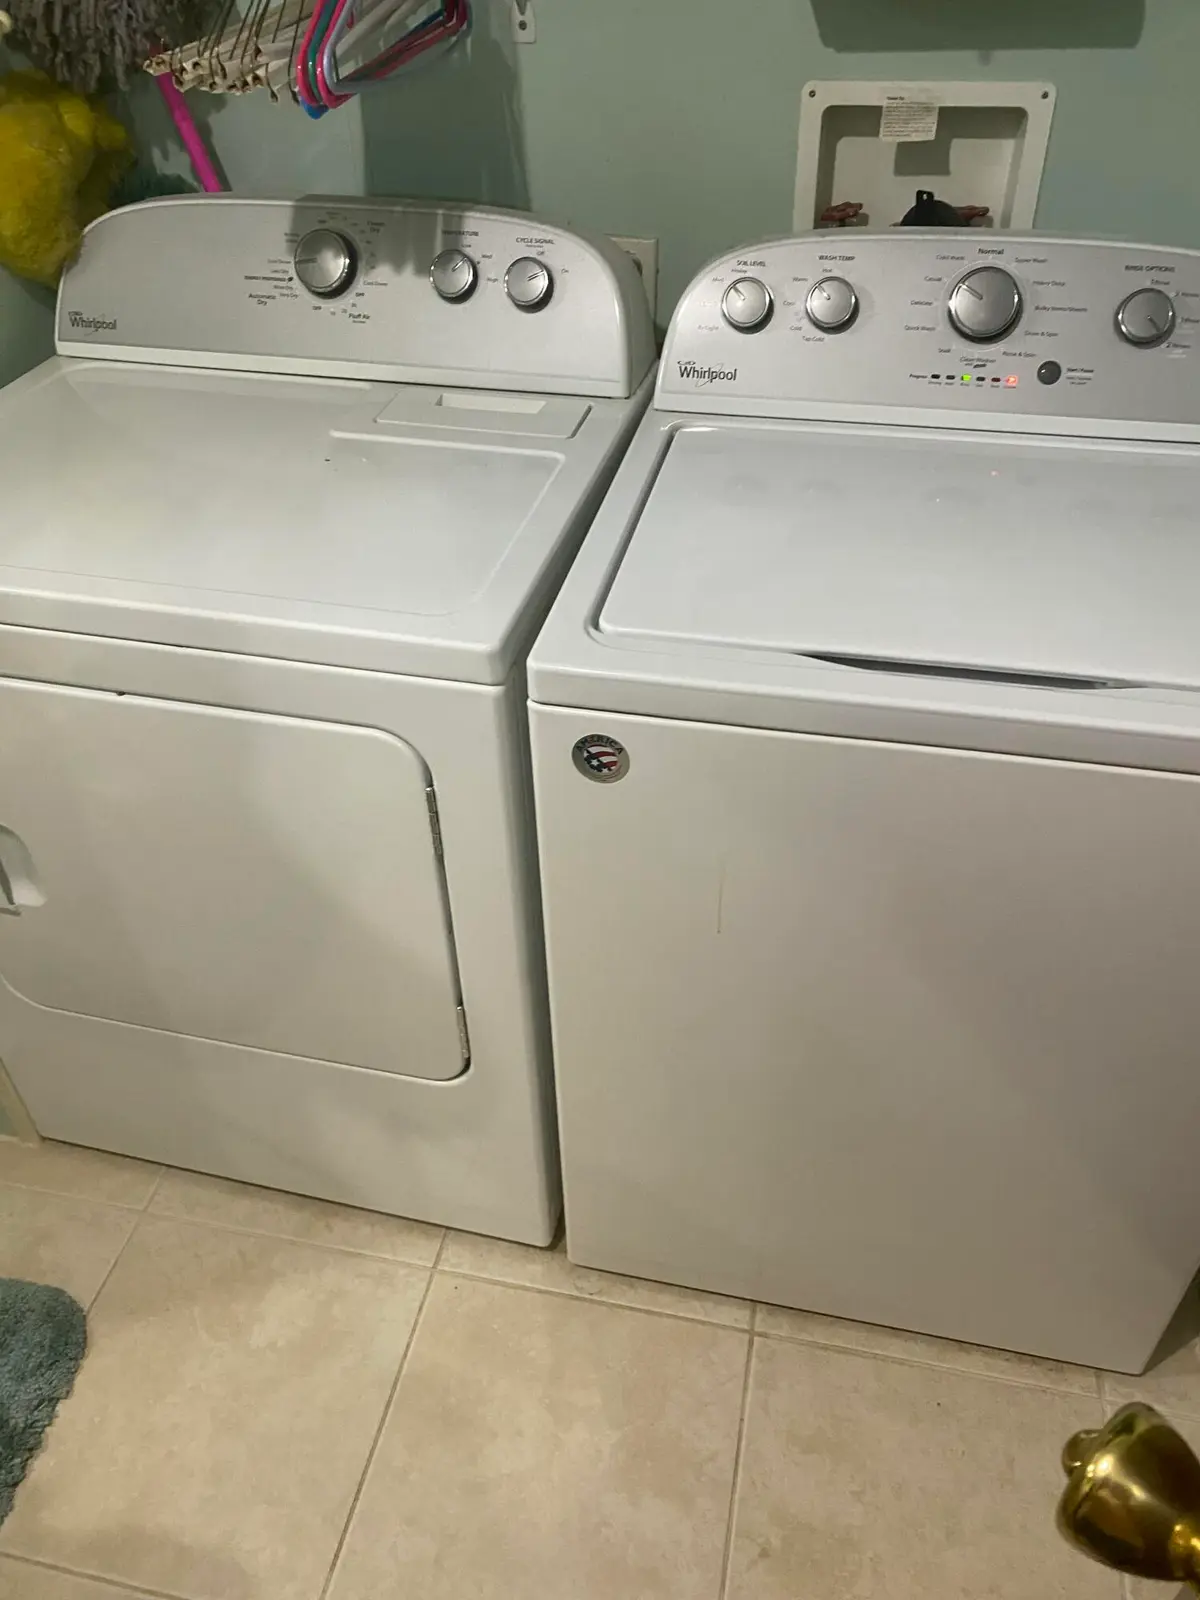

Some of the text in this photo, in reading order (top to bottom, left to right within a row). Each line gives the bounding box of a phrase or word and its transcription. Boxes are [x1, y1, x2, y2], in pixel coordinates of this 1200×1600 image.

[69, 316, 117, 331] Whirlpool
[679, 366, 738, 383] Whirlpool
[576, 735, 623, 754] AMERICA
